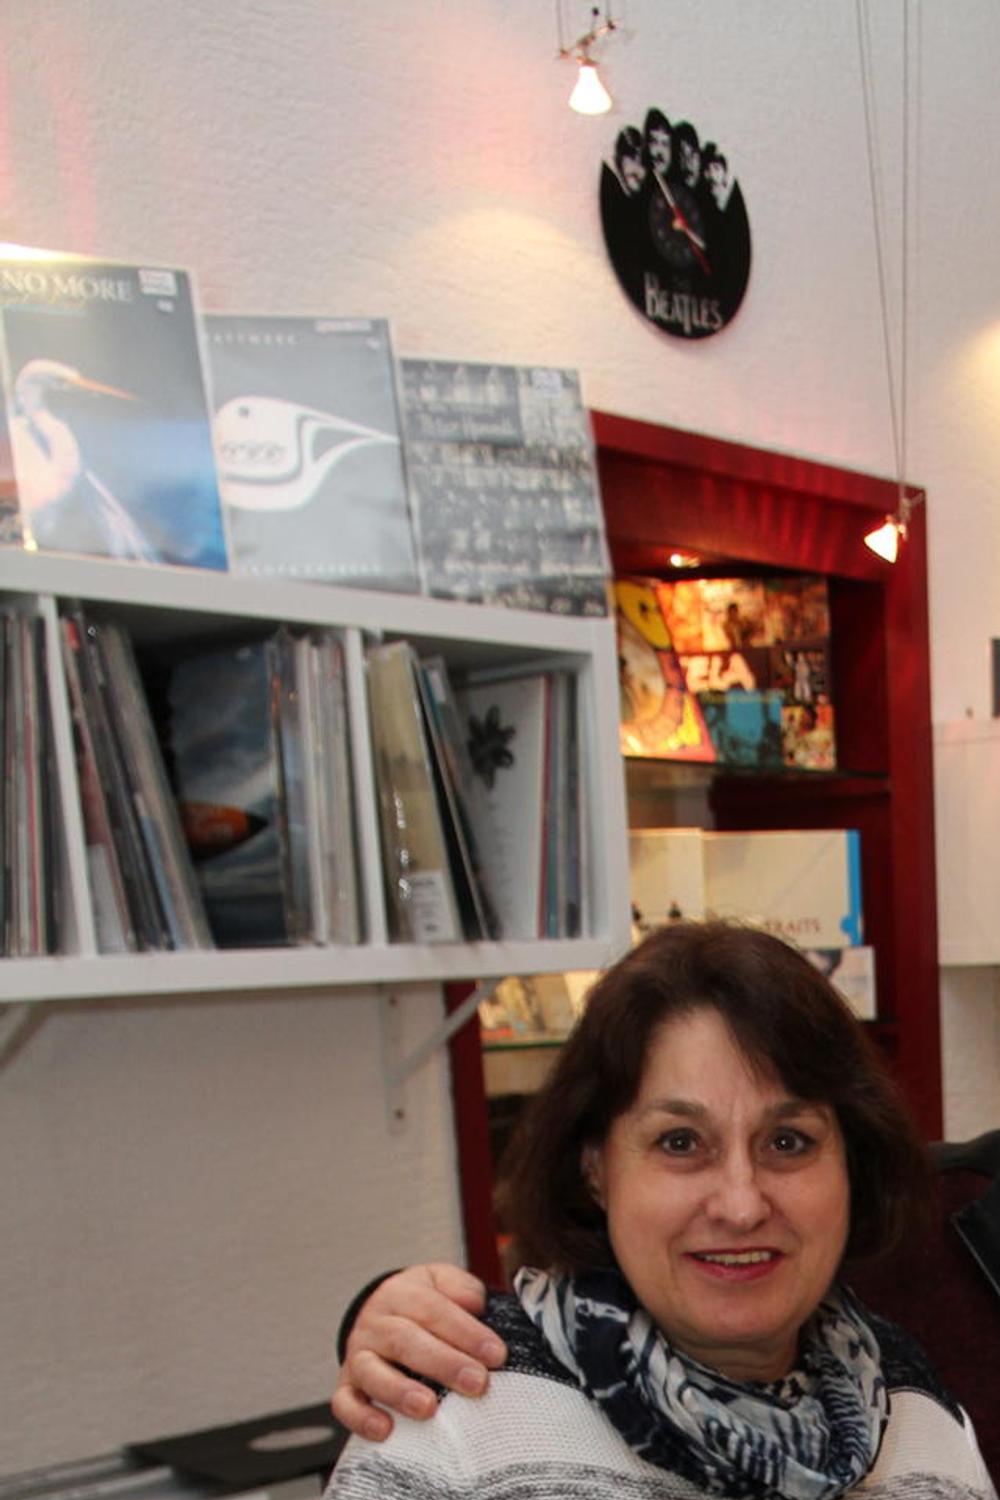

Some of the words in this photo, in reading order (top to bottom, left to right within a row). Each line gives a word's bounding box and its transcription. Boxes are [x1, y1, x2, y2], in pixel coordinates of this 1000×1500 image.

[1, 270, 48, 294] NO
[49, 273, 132, 303] MORE
[643, 272, 723, 334] BEATLES
